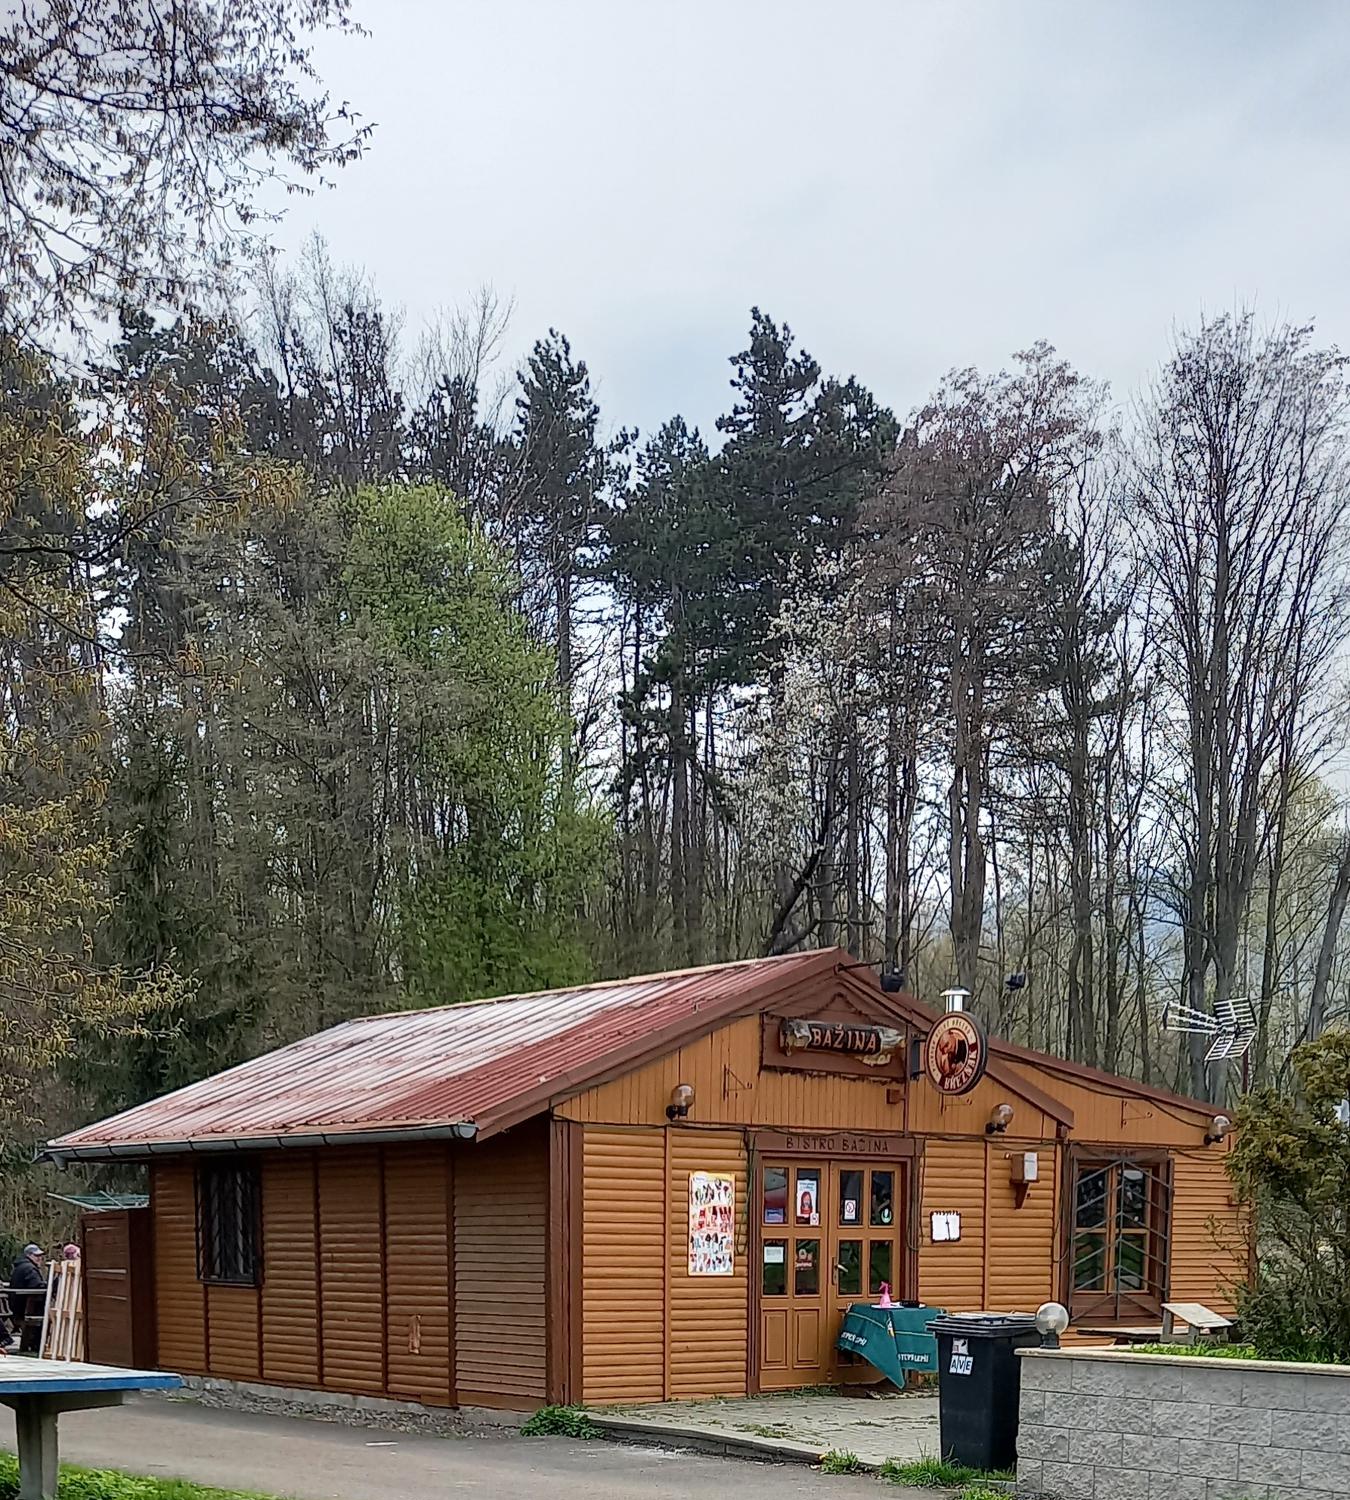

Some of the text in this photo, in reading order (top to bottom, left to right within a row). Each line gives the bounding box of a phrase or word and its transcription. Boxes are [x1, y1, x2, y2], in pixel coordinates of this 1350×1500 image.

[811, 1023, 877, 1052] BAŽINA
[786, 1136, 835, 1150] BISTRO
[951, 1357, 972, 1372] AVE
